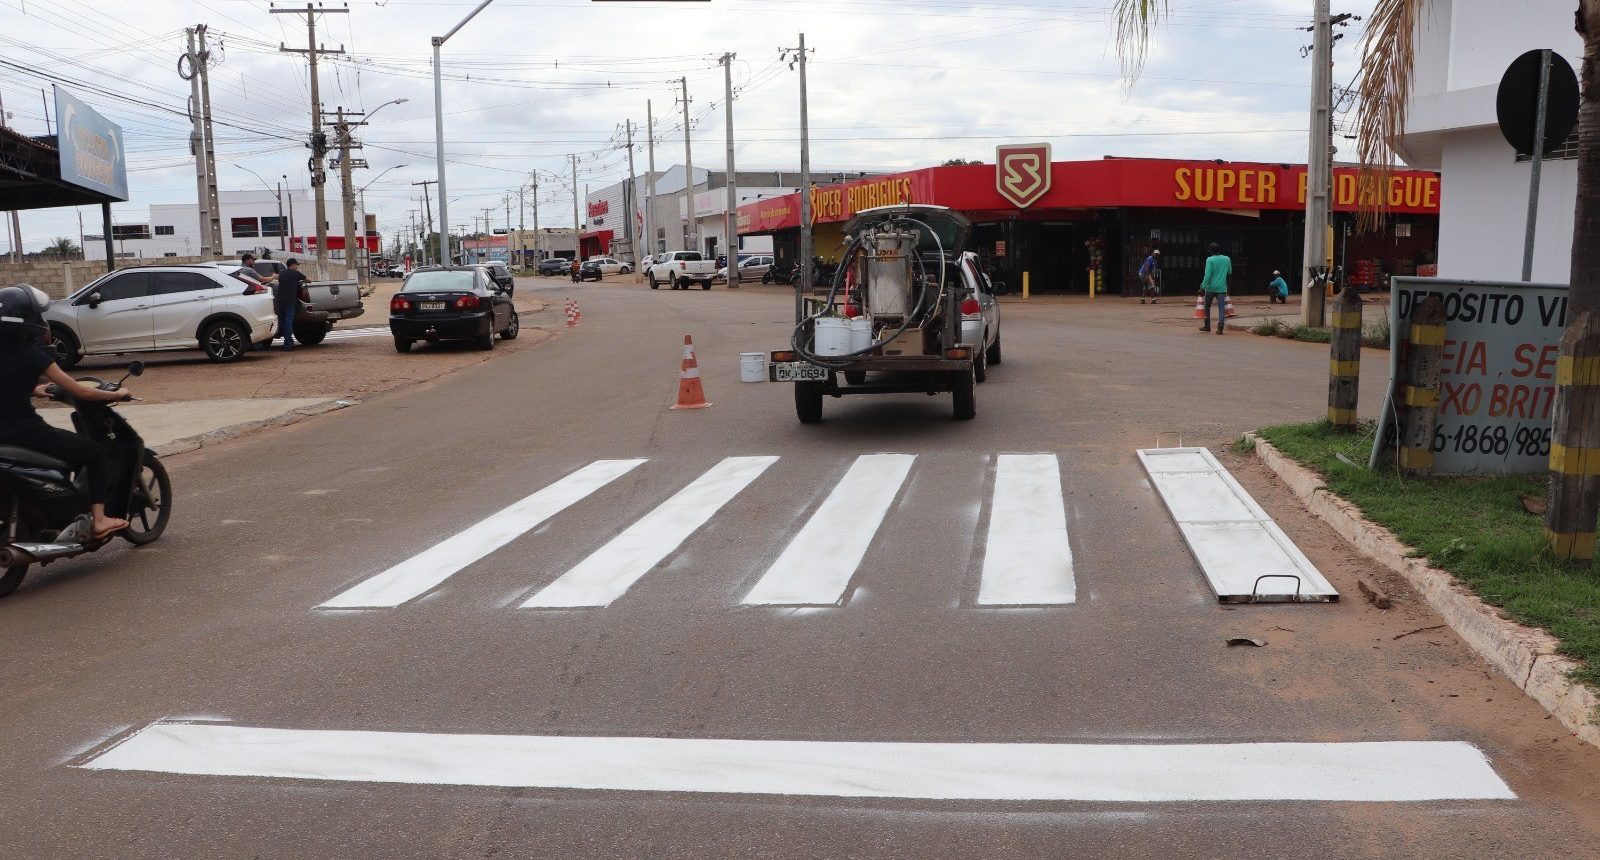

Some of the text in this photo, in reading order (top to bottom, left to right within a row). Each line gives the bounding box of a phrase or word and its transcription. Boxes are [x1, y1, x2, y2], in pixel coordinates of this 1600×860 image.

[809, 177, 911, 226] SUPER RODRIGUES
[1174, 167, 1439, 208] SUPER DRIGUE
[1537, 295, 1568, 327] VI
[1510, 343, 1559, 380] SE
[1488, 383, 1556, 420] BRIT
